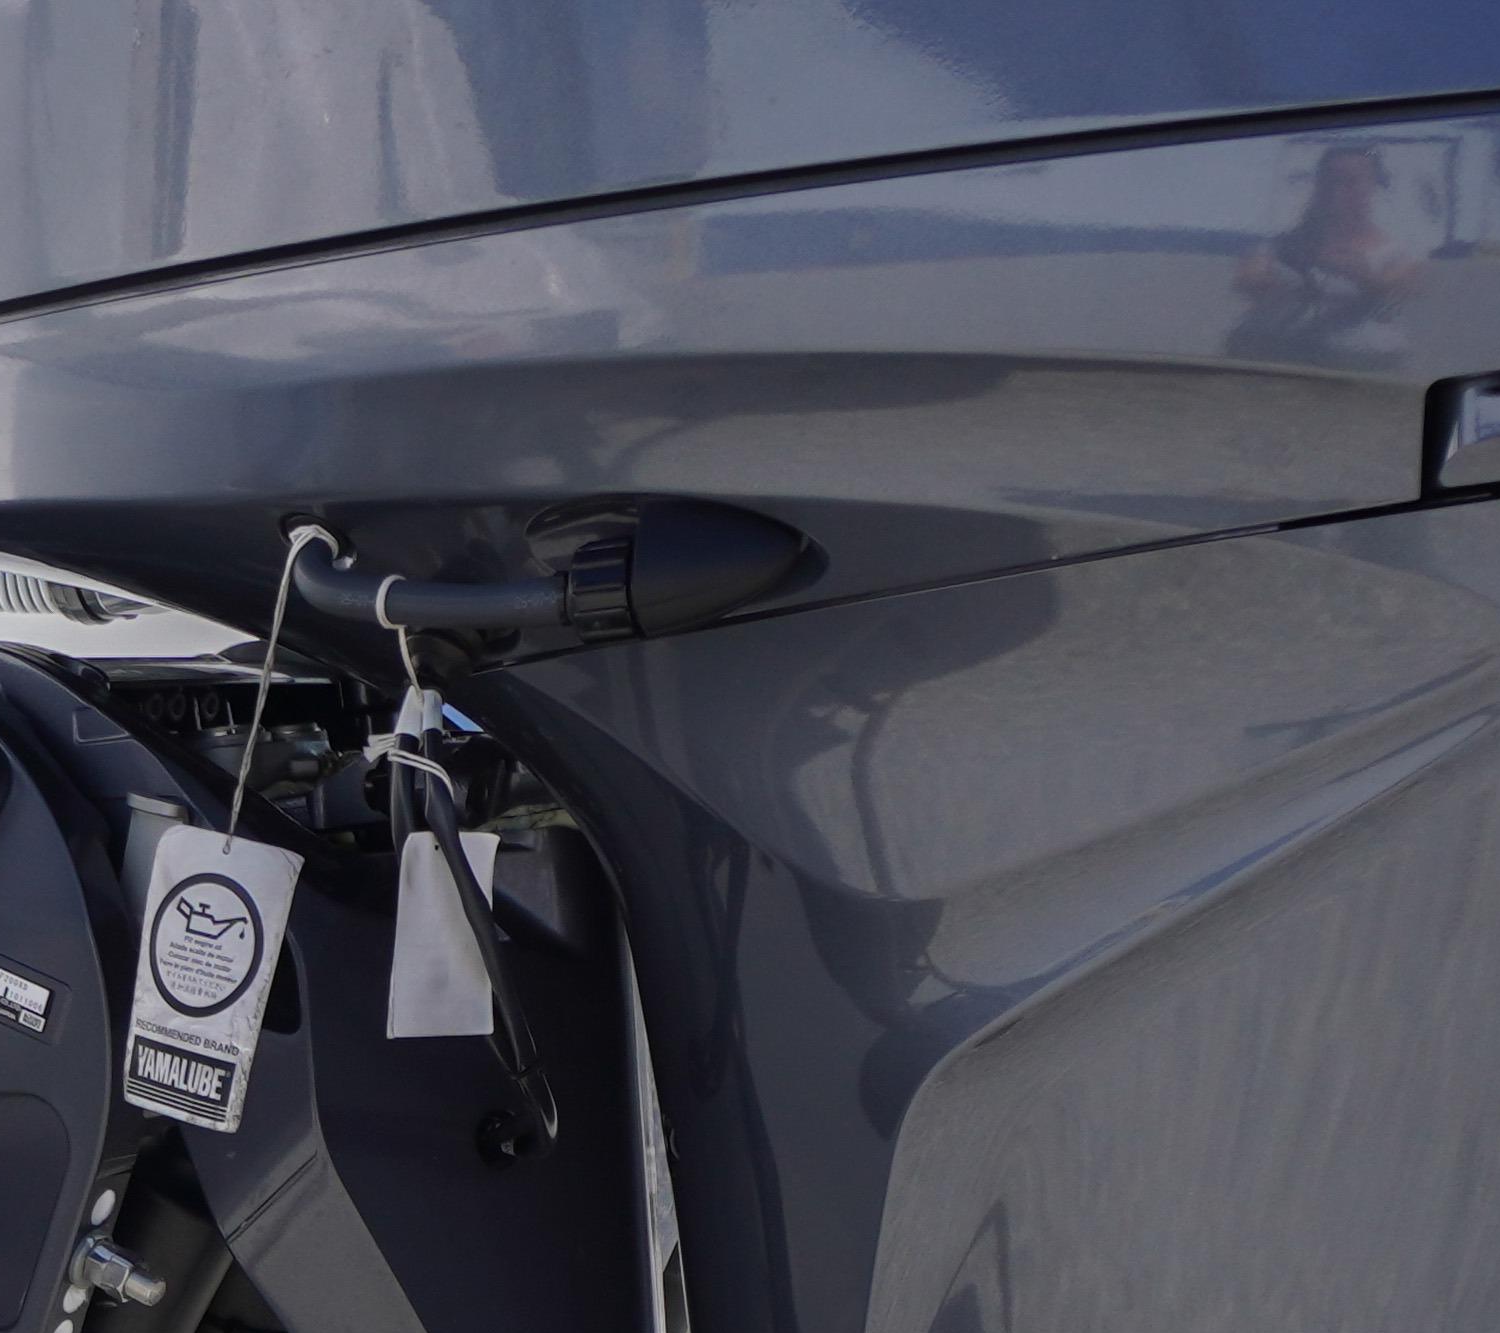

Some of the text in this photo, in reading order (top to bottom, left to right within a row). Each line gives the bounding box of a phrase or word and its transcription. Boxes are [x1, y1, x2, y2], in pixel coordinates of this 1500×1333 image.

[136, 1018, 240, 1057] RECOMMENDED BRAND
[137, 1044, 226, 1101] YAMALUBE
